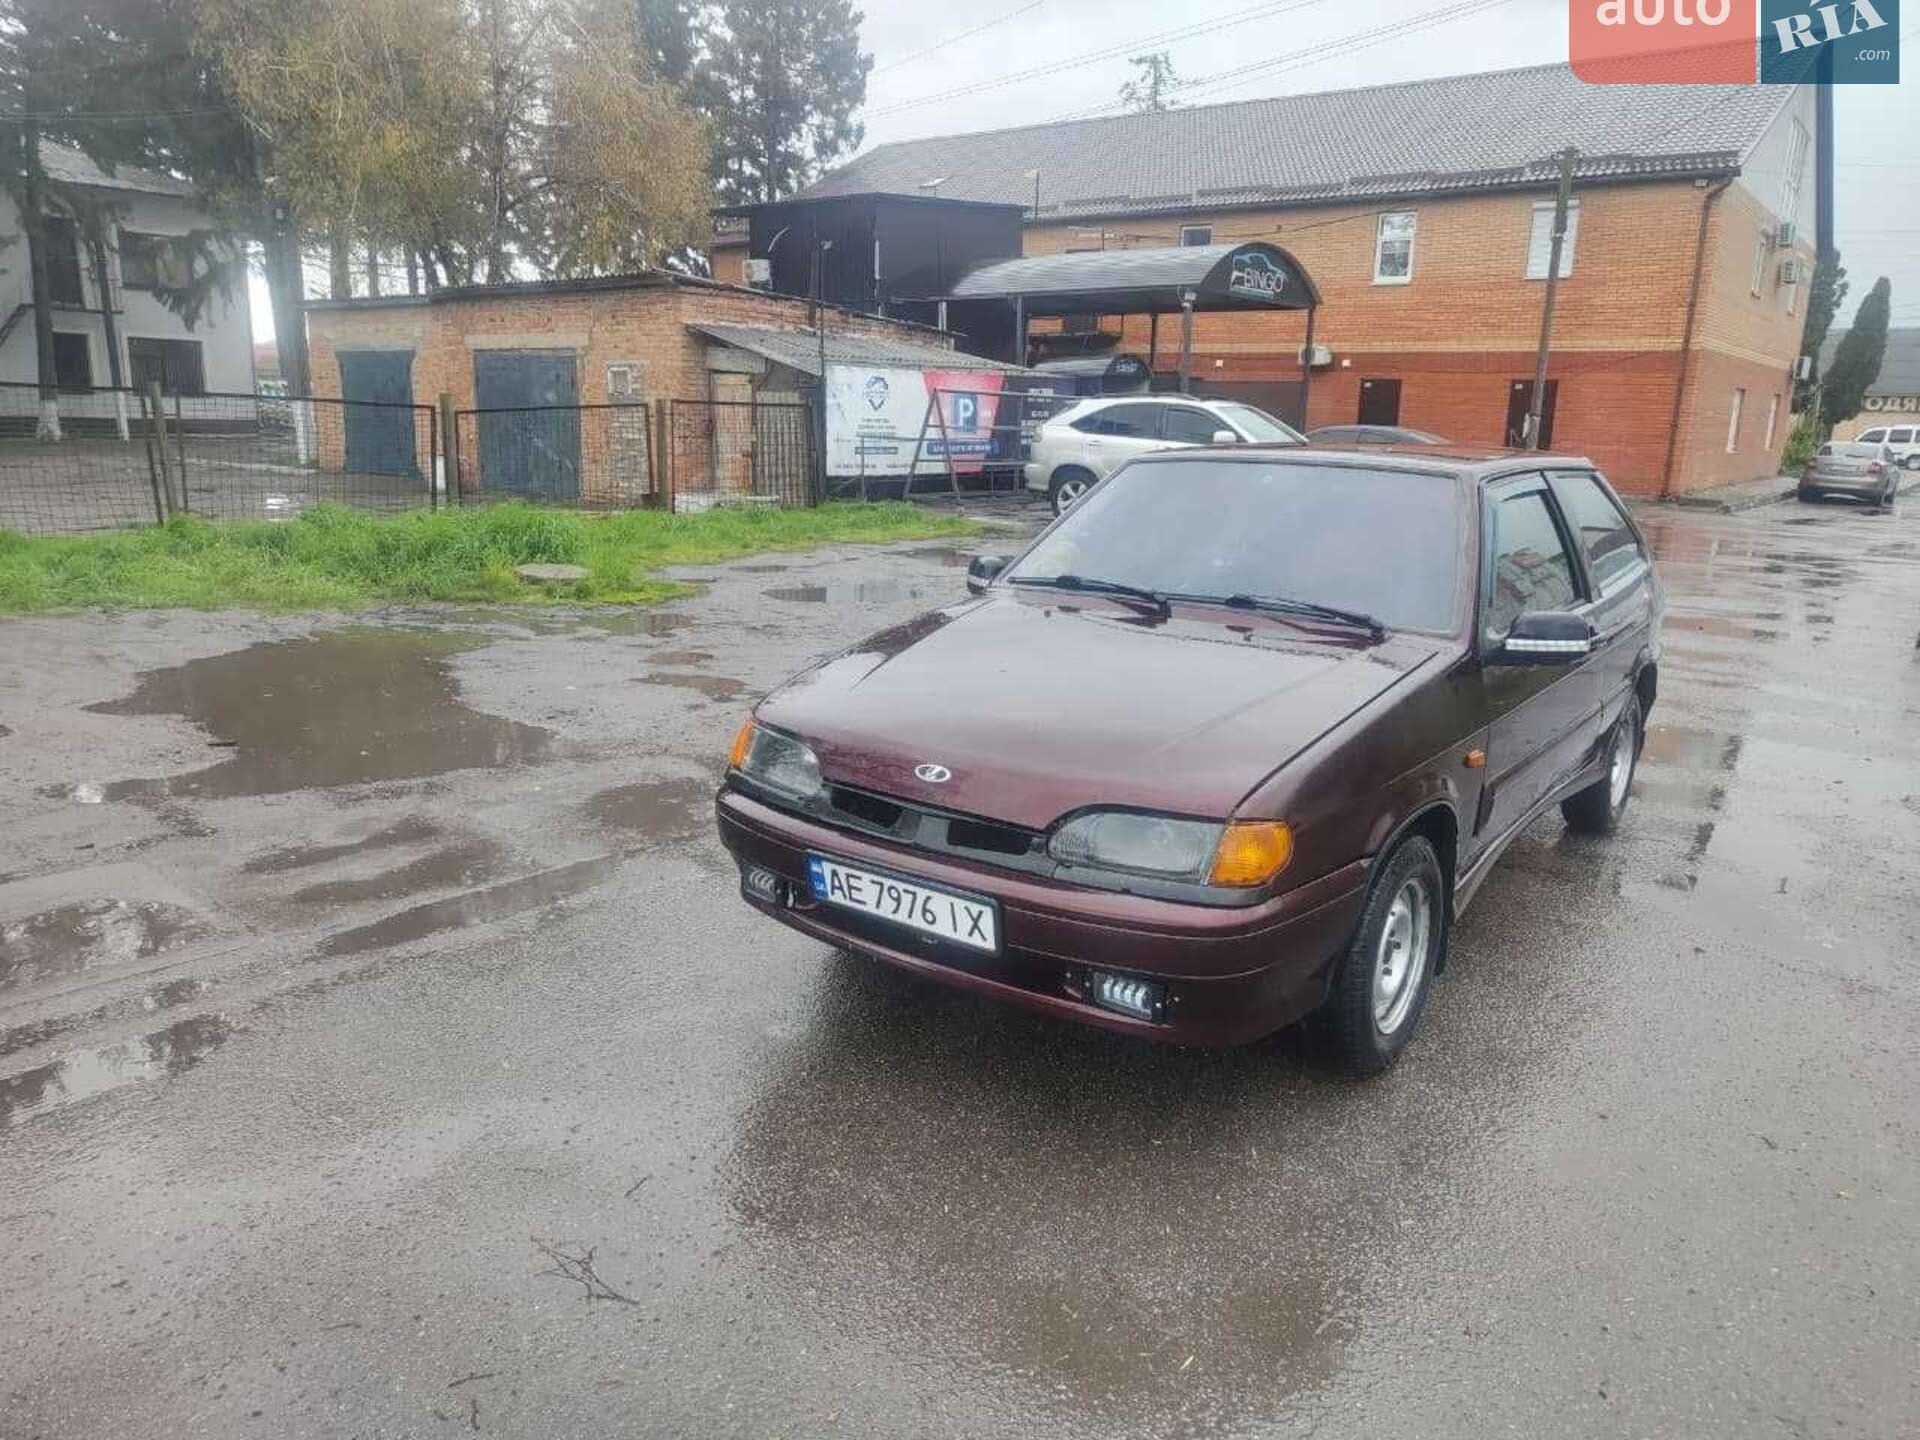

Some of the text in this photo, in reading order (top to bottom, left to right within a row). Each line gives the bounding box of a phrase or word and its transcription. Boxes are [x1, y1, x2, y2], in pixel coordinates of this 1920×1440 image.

[1244, 267, 1284, 293] BINGO
[1864, 396, 1920, 413] ОДЯ
[830, 869, 987, 942] AE 7976 IX
